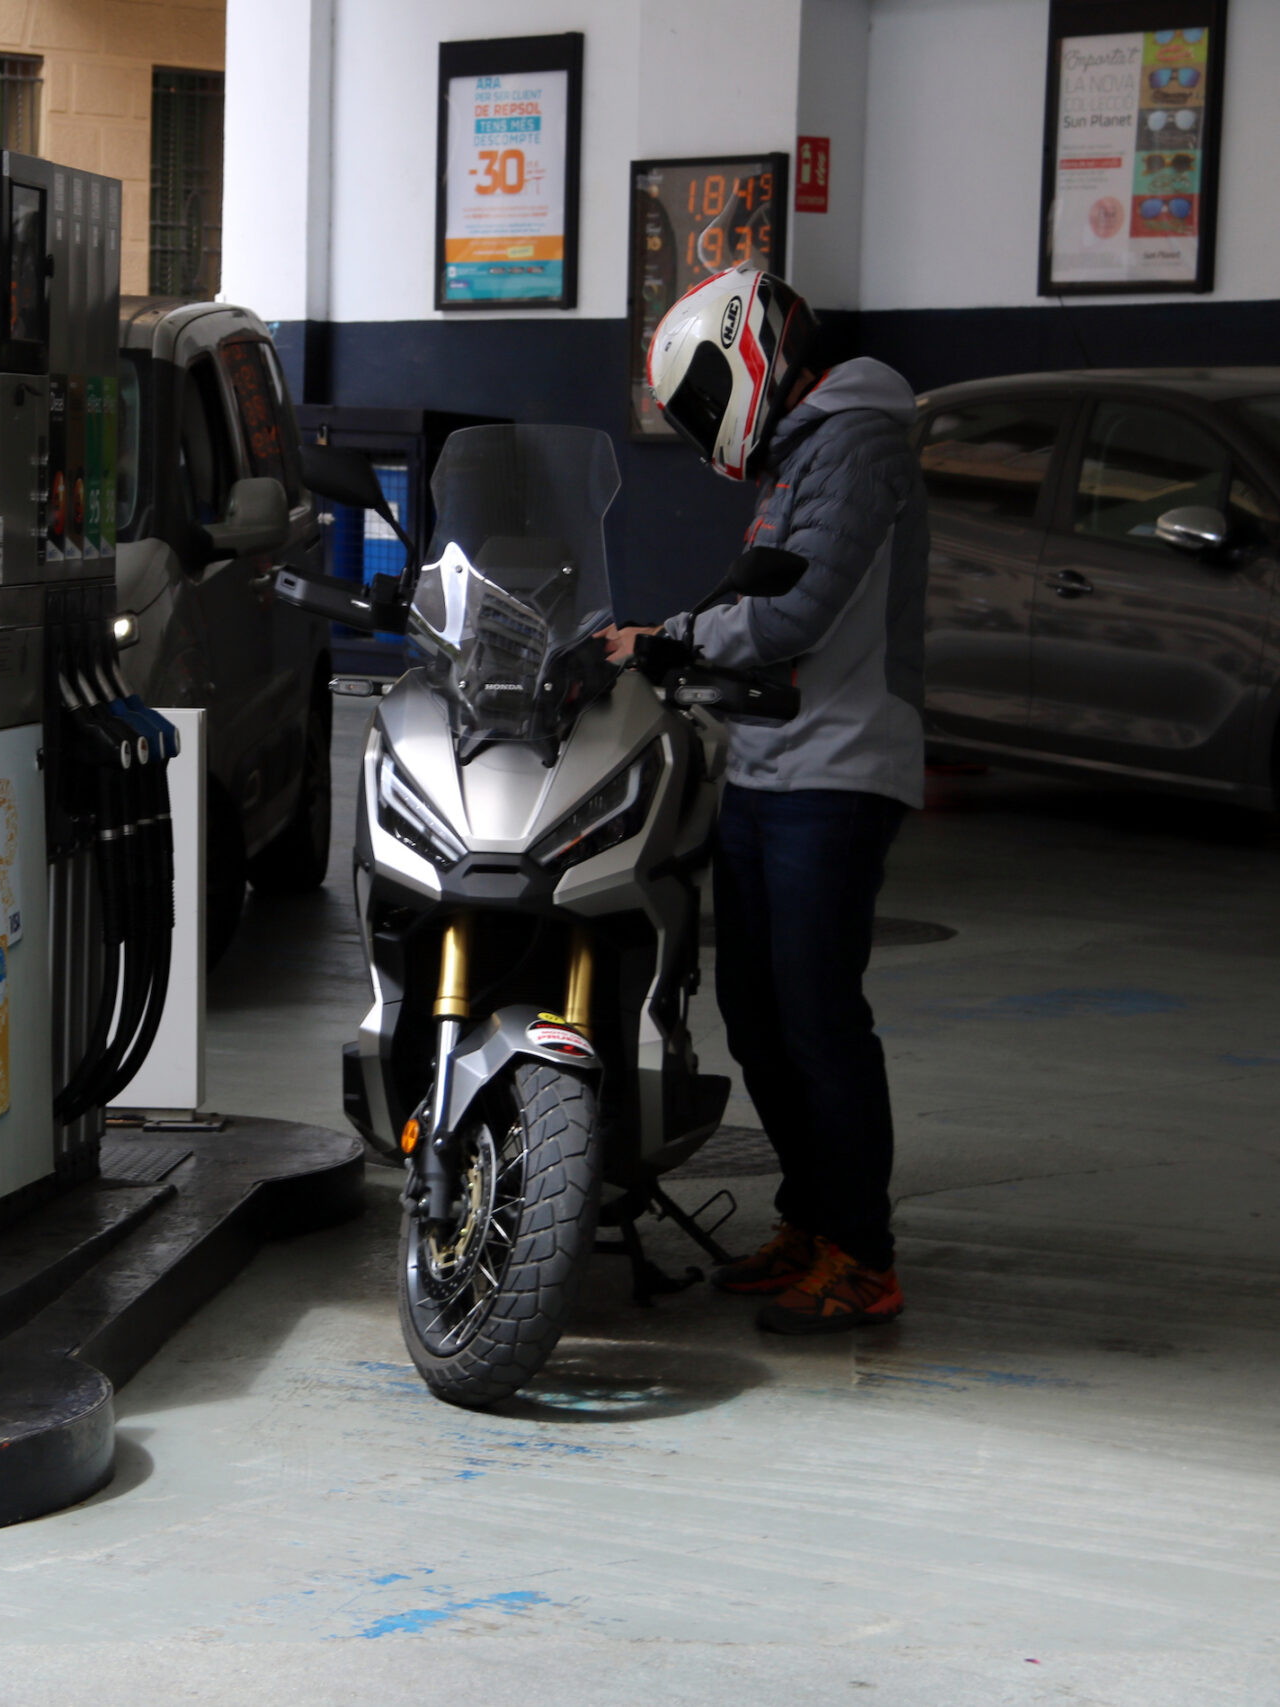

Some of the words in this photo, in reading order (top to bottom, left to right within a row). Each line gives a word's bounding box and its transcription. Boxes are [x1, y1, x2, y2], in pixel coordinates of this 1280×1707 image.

[476, 77, 501, 89] ARA
[512, 88, 542, 100] CLIENT
[474, 104, 489, 117] DE
[494, 101, 542, 116] REPSOL
[480, 119, 507, 132] TENS
[1063, 115, 1087, 129] Sun
[1090, 114, 1132, 128] Planet
[474, 133, 541, 146] DESCOMPTE
[723, 303, 739, 341] HJC
